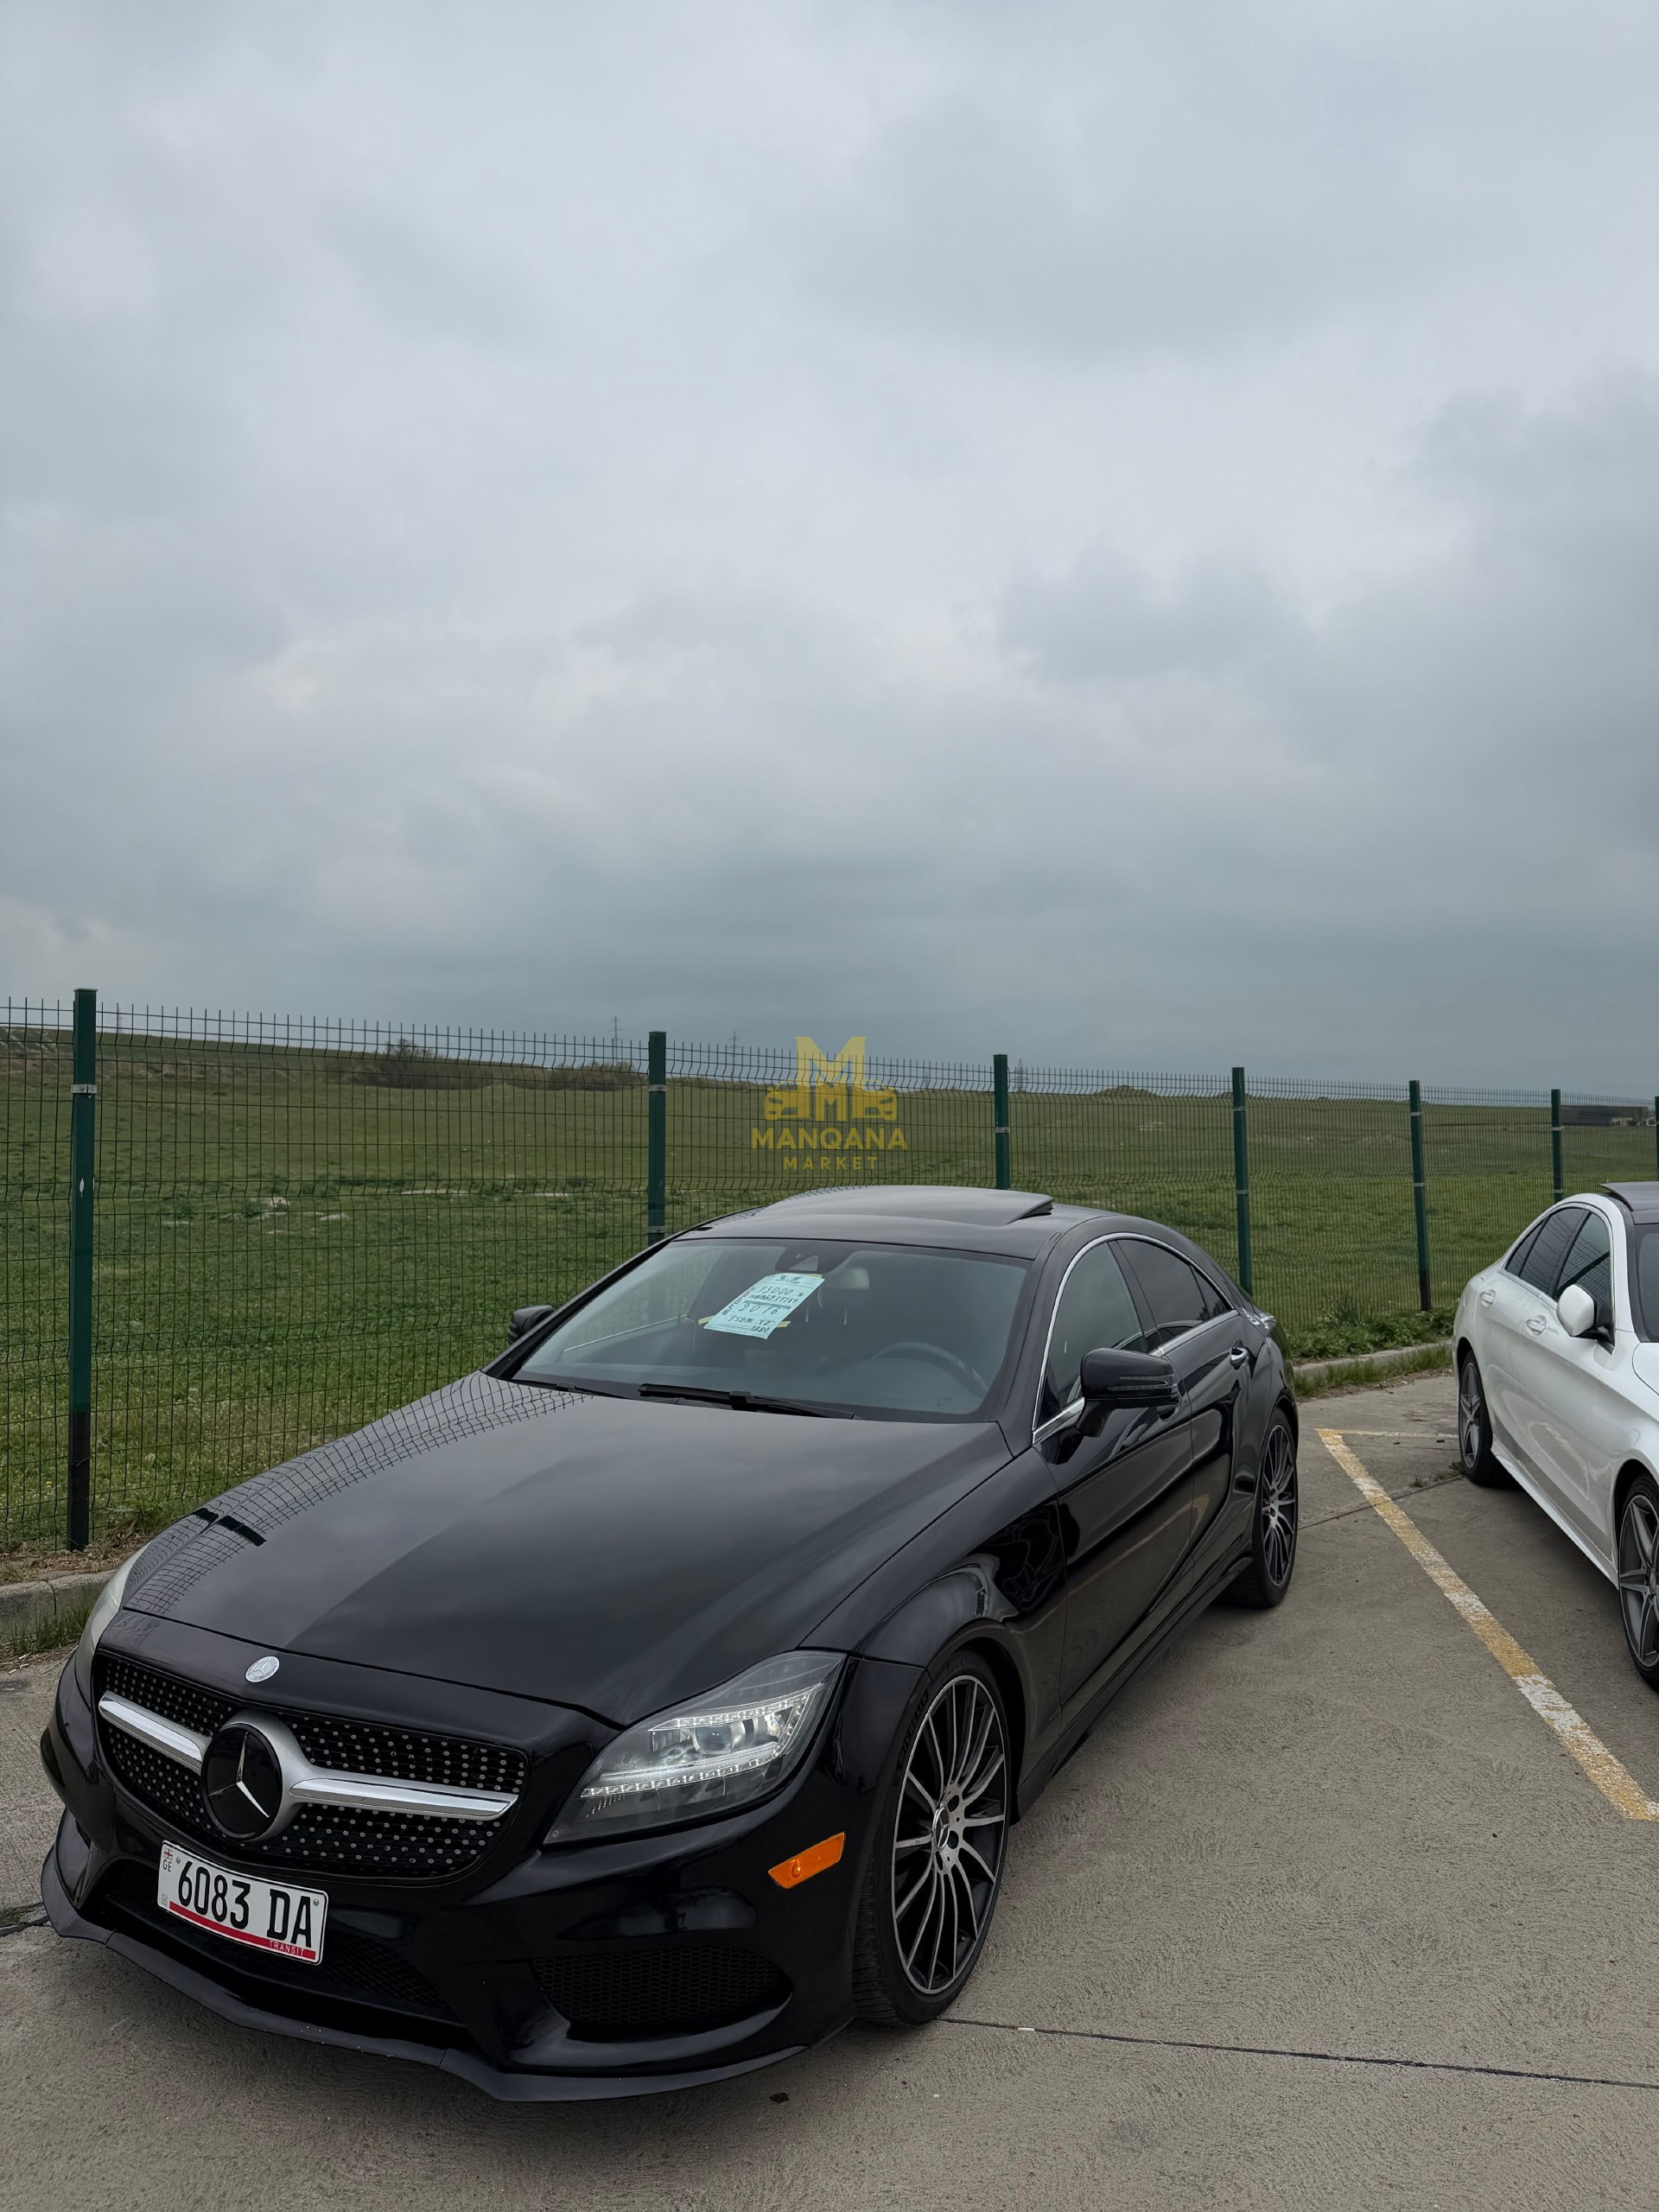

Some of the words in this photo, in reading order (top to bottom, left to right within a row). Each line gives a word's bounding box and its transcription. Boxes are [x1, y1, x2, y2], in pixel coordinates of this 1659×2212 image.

[162, 1859, 173, 1872] GE
[177, 1860, 251, 1930] 6083
[266, 1888, 312, 1948] DA
[269, 1940, 306, 1956] TRANSIT
